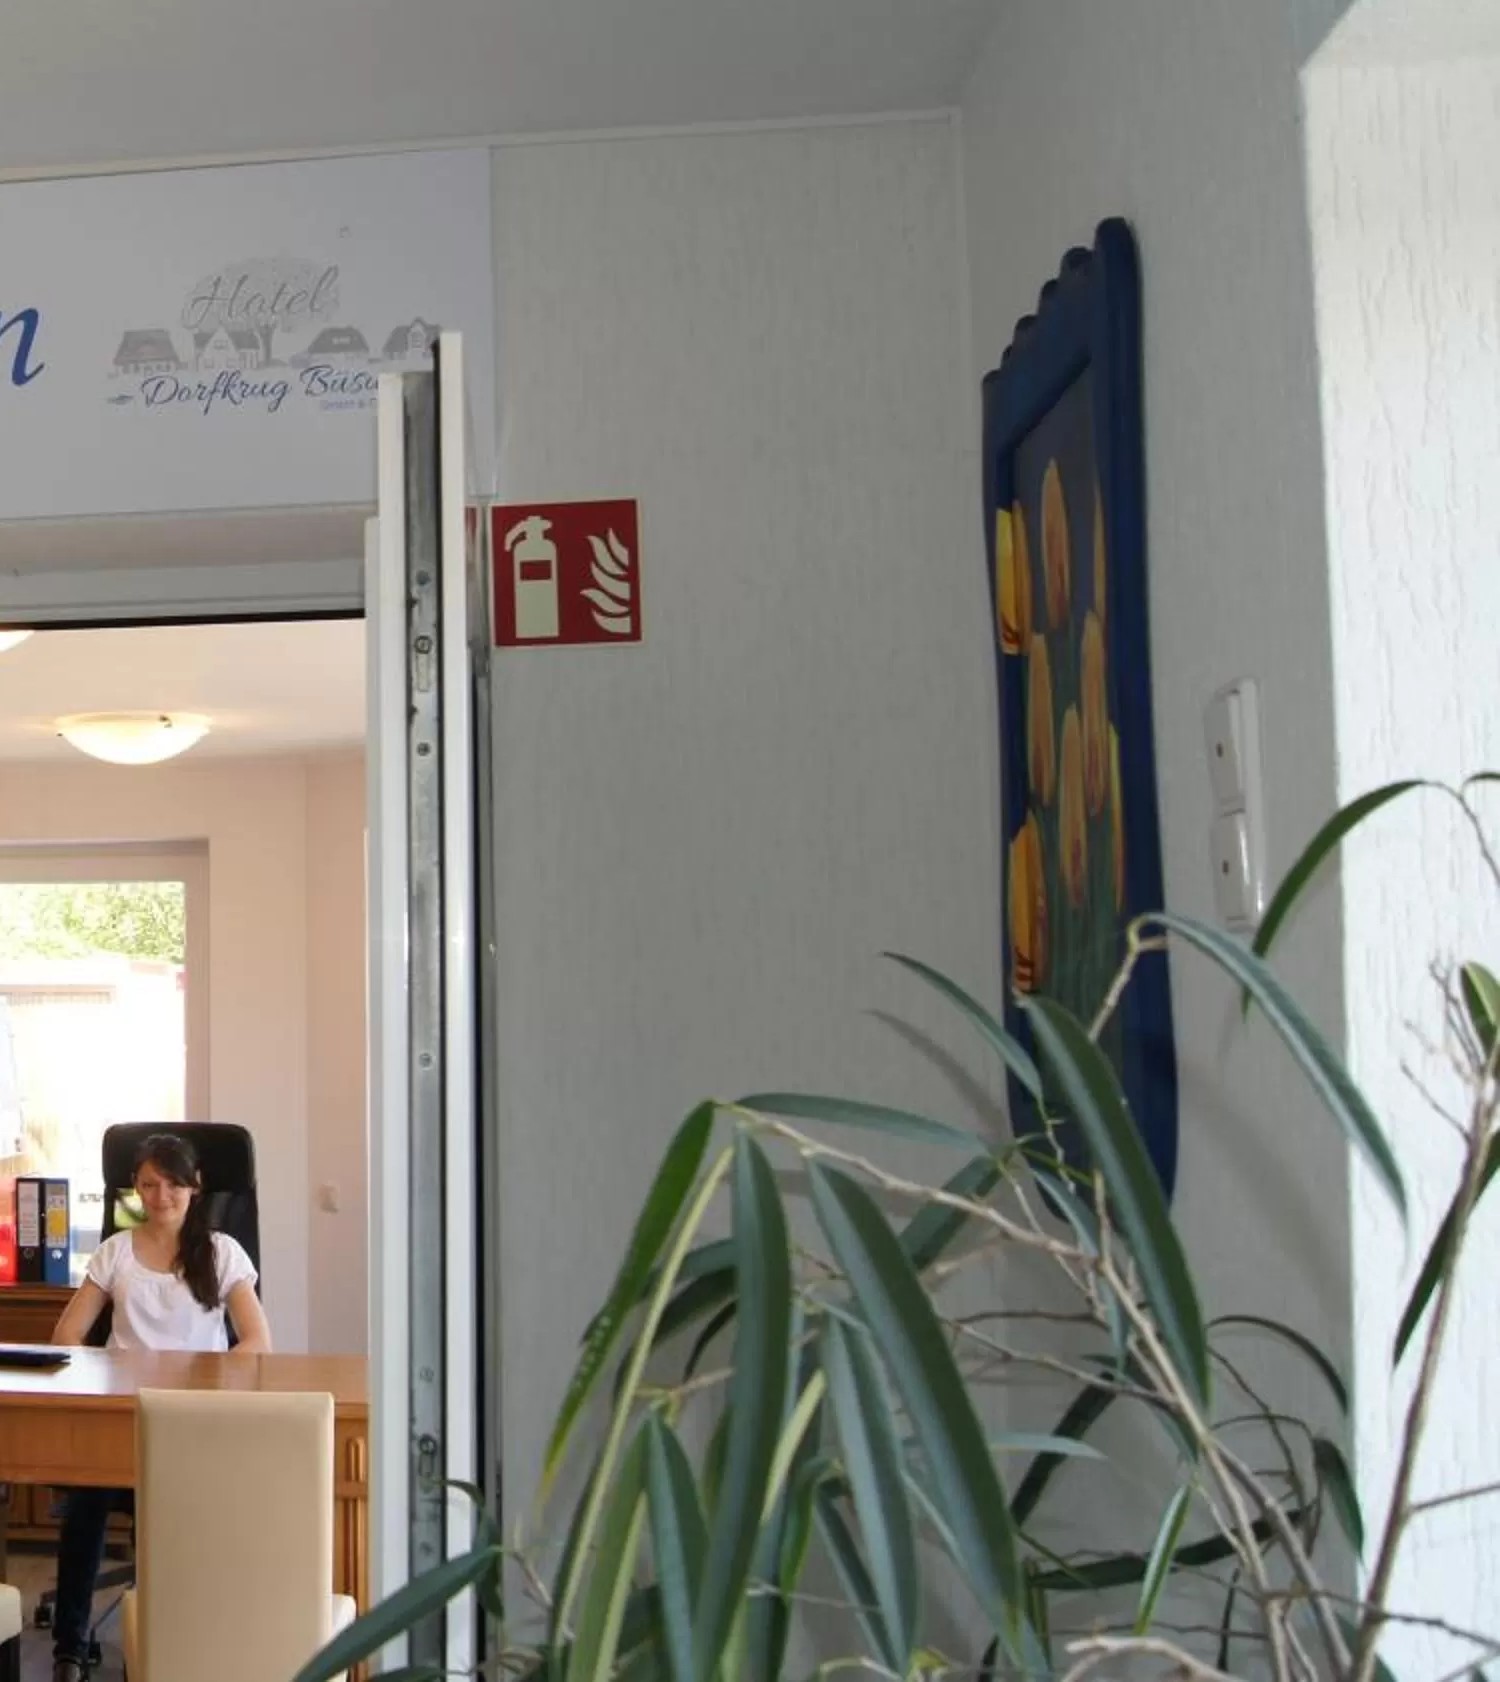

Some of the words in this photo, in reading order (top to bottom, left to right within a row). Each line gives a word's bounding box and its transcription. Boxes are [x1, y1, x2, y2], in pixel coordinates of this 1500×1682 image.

[182, 264, 339, 330] Hotel
[140, 370, 293, 416] Dorfkrug
[299, 364, 379, 396] Büsu
